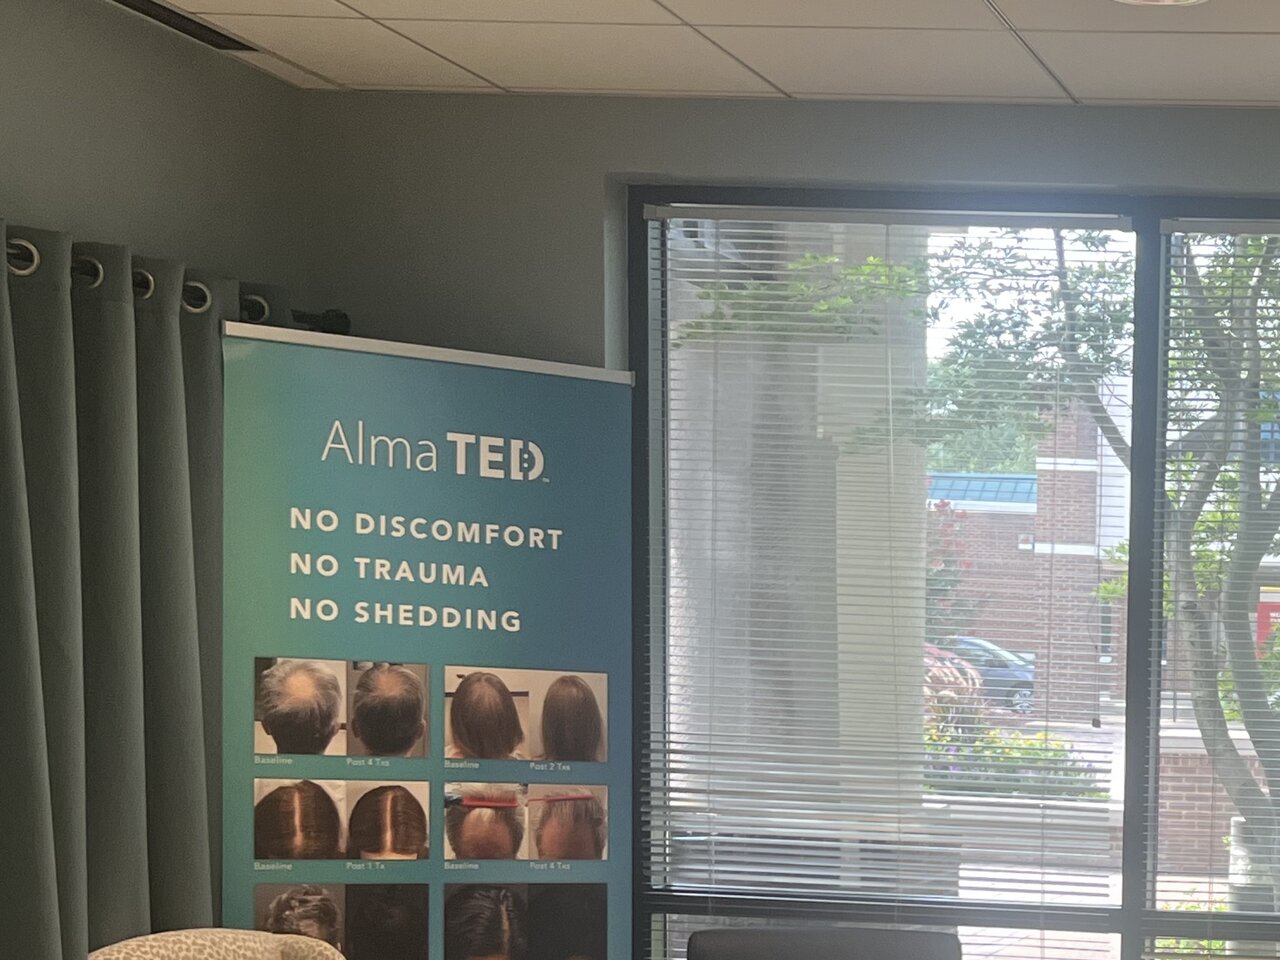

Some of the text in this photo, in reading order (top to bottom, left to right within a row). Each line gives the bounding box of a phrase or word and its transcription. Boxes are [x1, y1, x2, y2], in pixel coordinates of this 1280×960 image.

[321, 420, 544, 481] Alma TED
[290, 507, 563, 550] NO DISCOMFORT
[290, 552, 489, 587] NO TRAUMA
[290, 597, 521, 632] NO SHEDDING
[254, 756, 293, 765] Baseline
[346, 758, 365, 766] Post
[444, 760, 480, 769] Baseline
[529, 762, 548, 770] Post
[254, 862, 293, 871] Baseline
[346, 862, 365, 870] Post
[444, 862, 480, 870] Baseline
[529, 862, 548, 870] Post
